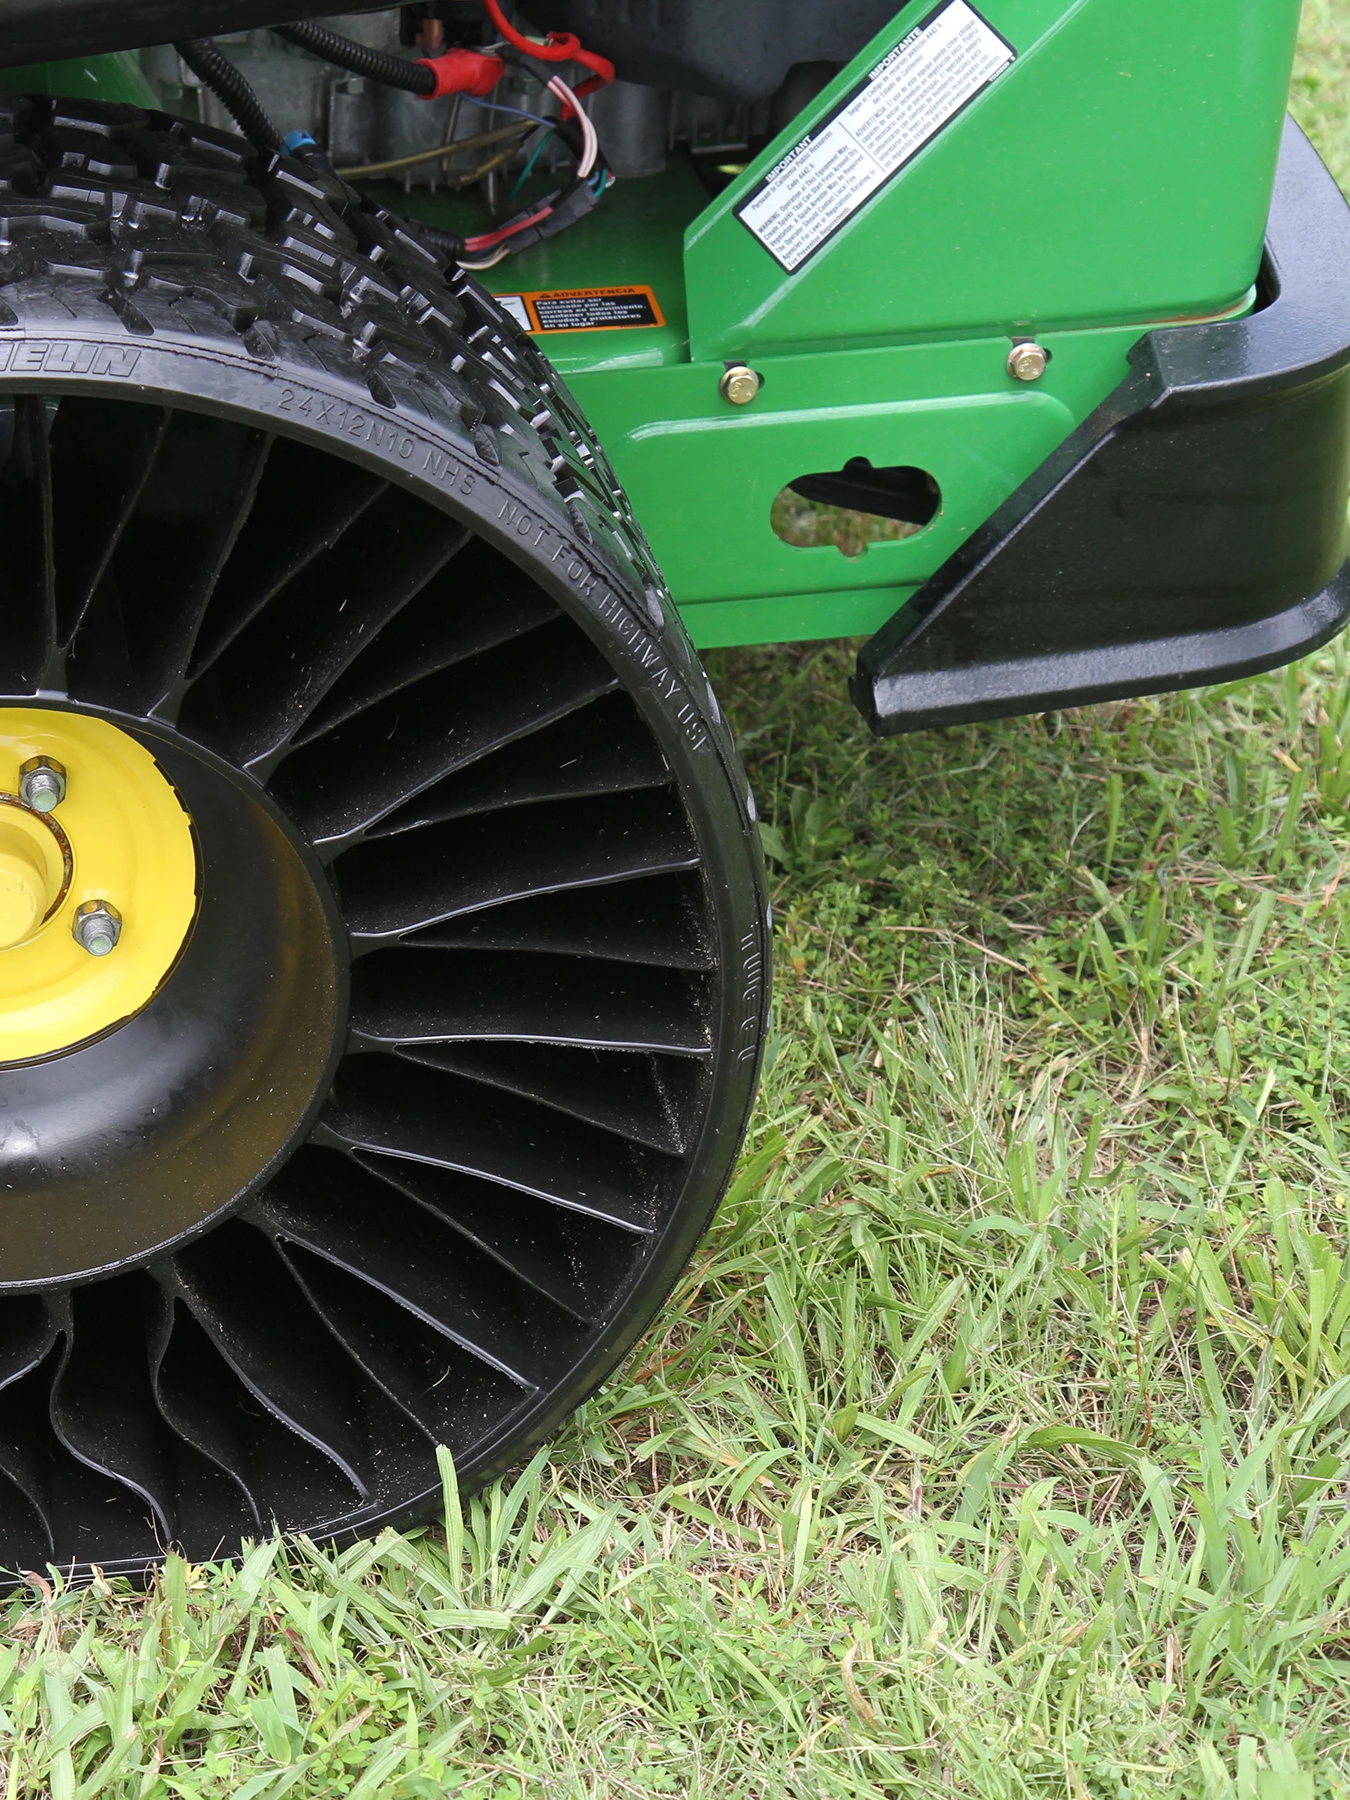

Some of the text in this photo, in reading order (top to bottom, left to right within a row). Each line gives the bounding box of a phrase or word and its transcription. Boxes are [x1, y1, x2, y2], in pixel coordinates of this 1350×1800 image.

[868, 27, 923, 80] IMPORTANTE
[765, 135, 812, 183] IMPORTANT
[553, 287, 636, 298] ADVERTENCIA
[278, 388, 477, 497] 24X12N10 NHS
[498, 499, 550, 549] NOT
[551, 546, 598, 597] FOR
[597, 592, 681, 700] HIGHWAY
